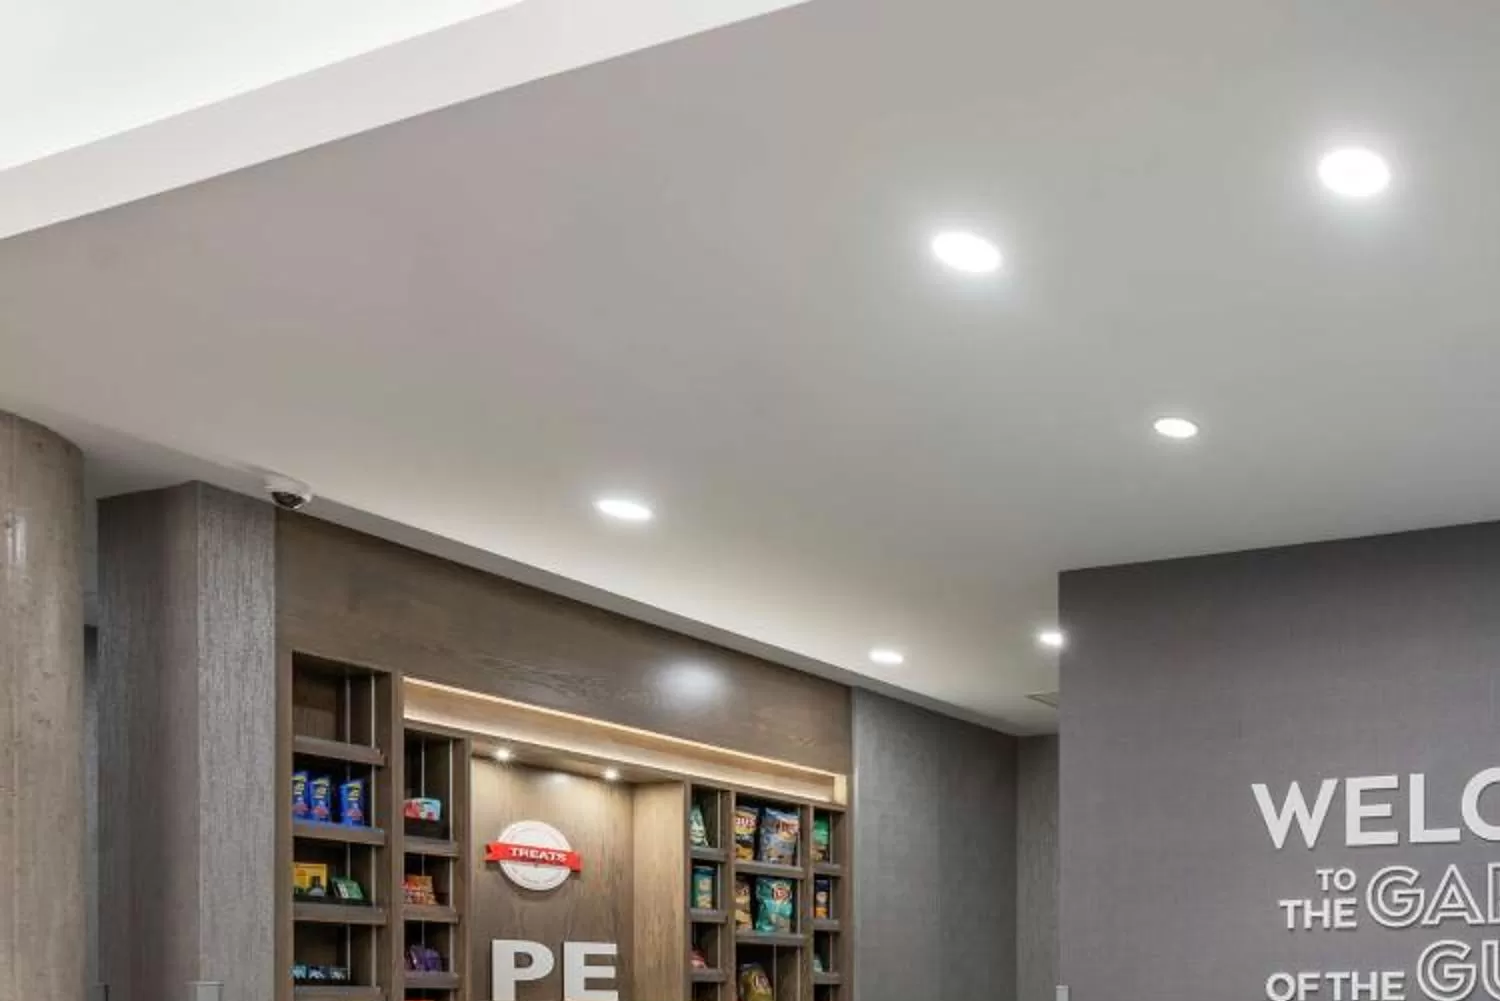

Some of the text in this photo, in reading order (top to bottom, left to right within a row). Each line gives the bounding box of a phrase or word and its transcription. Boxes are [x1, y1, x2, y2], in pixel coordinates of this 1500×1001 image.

[511, 847, 568, 863] TREATS
[1316, 868, 1356, 892] TO
[1279, 897, 1358, 930] THE
